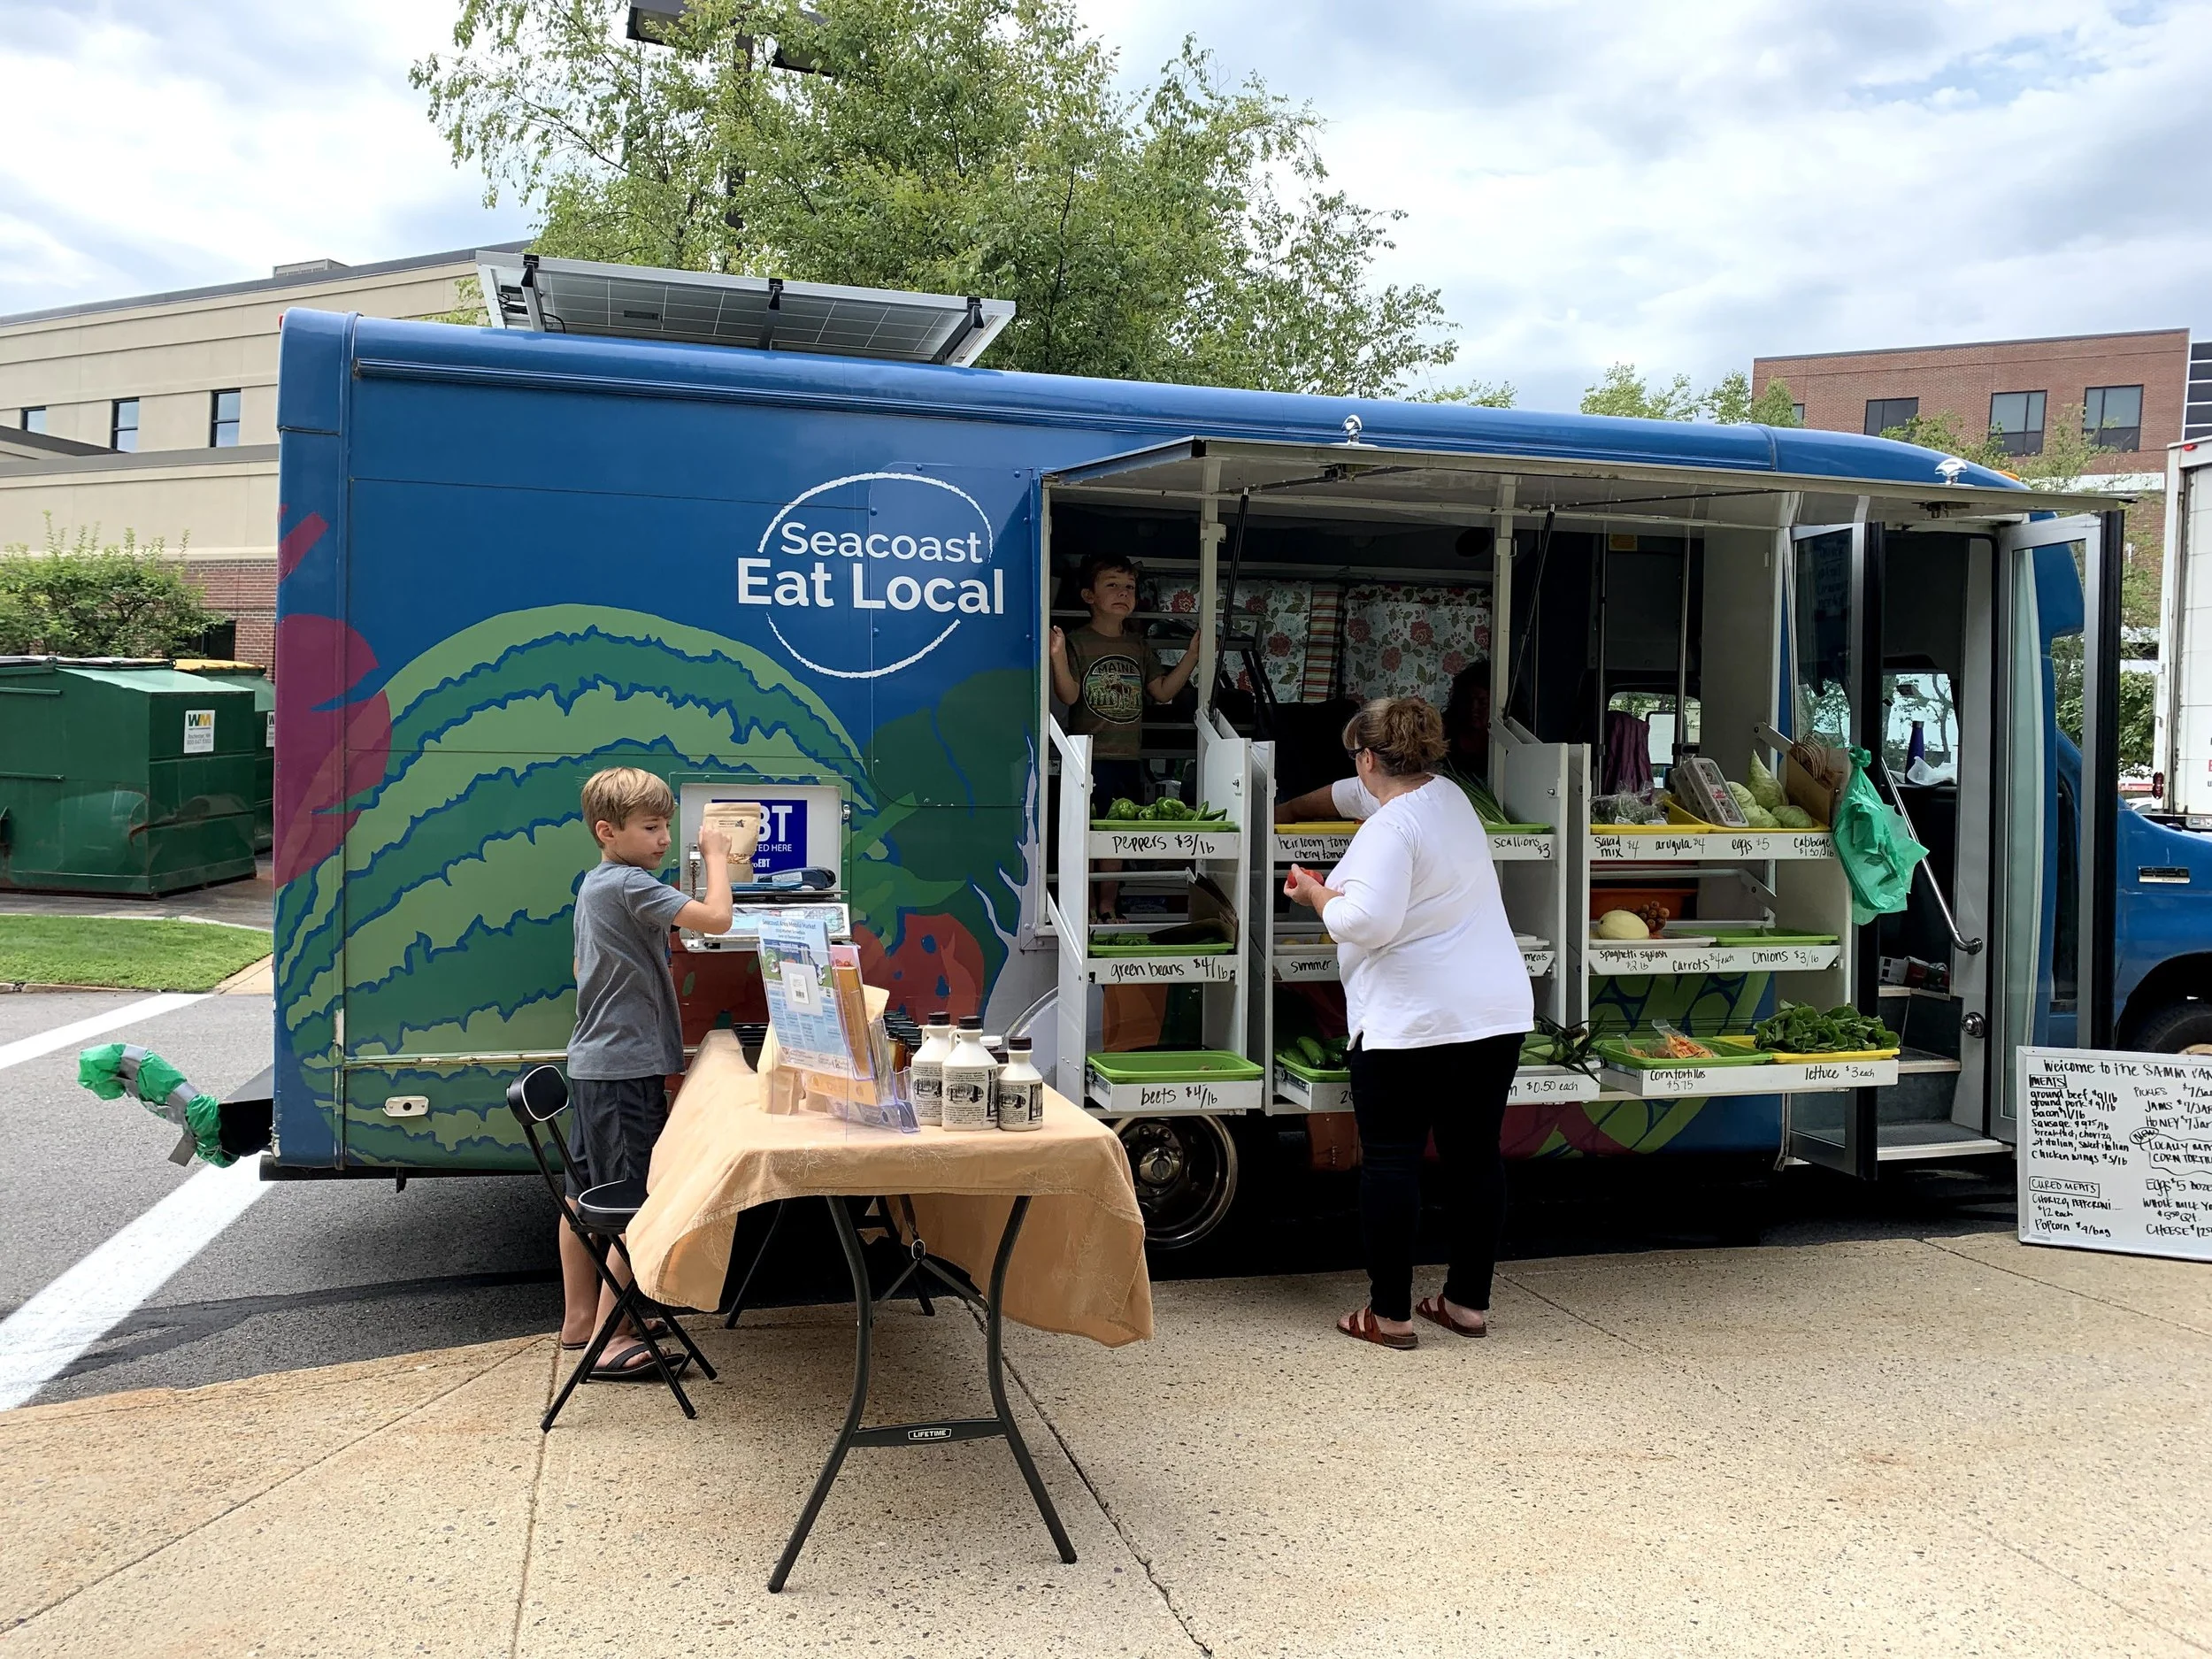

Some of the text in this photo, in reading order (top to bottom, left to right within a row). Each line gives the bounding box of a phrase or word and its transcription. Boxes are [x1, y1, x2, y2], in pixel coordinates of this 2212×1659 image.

[780, 521, 984, 564] Seacoast
[737, 557, 1004, 615] Eat Local
[1098, 662, 1136, 673] MAINE
[188, 714, 211, 726] WM
[757, 805, 793, 842] BT
[1112, 834, 1167, 854] peppers
[1277, 834, 1325, 850] heirloom
[1655, 838, 1706, 856] arugula $4
[1732, 838, 1770, 856] eggs $5
[1294, 850, 1321, 861] cherry
[1537, 843, 1551, 858] $3
[1601, 848, 1624, 858] mix
[1627, 840, 1640, 859] $4
[1600, 949, 1668, 962] spaghetti squash
[1110, 964, 1147, 984] green
[1148, 962, 1186, 978] beans
[1625, 960, 1638, 972] $2
[1805, 1064, 1875, 1080] lettuce $3 each
[2098, 1061, 2111, 1075] to
[2142, 1064, 2187, 1079] SAMM
[1526, 1080, 1556, 1094] $0.50
[1559, 1080, 1578, 1092] each
[2031, 1075, 2067, 1088] MEATS
[1141, 1087, 1177, 1106] beets
[2030, 1087, 2064, 1102] ground
[2066, 1087, 2088, 1102] beef
[2133, 1086, 2168, 1097] PICKLES
[2030, 1095, 2062, 1110] ground
[2064, 1099, 2088, 1112] pork
[2144, 1099, 2173, 1113] JAMS
[2032, 1108, 2060, 1118] bacon
[2193, 1116, 2212, 1130] Jar
[2071, 1154, 2100, 1165] wings
[2153, 1153, 2182, 1164] CORN
[2032, 1179, 2097, 1194] CURED MEATS
[2170, 1178, 2186, 1192] $5
[2143, 1197, 2173, 1209] WHOLE
[2038, 1205, 2054, 1217] $12
[2146, 1224, 2191, 1237] CHEESE
